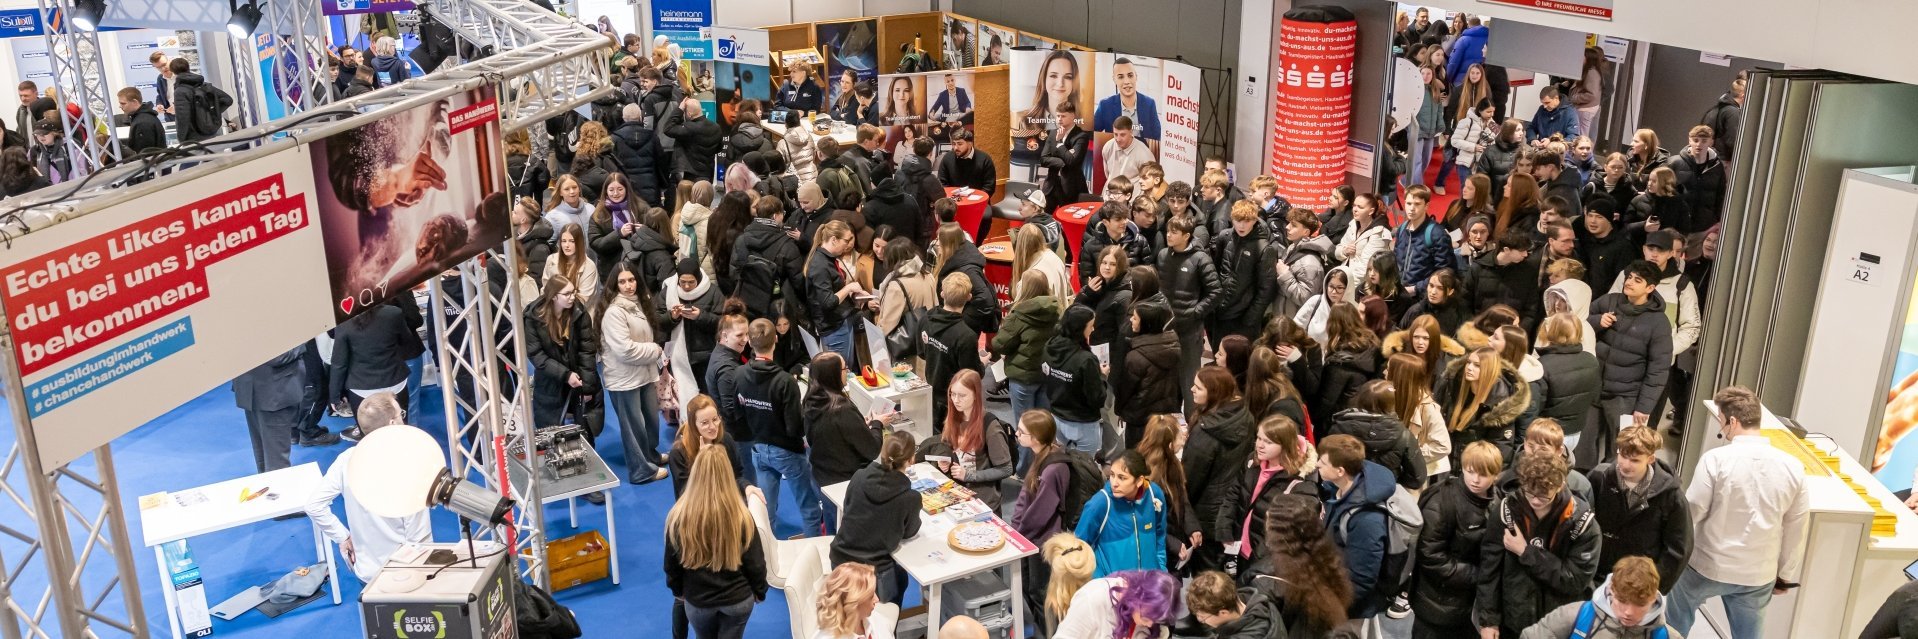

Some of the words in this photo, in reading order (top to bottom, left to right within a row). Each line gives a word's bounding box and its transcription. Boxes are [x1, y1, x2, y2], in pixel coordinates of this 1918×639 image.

[660, 9, 702, 17] heinemann
[1554, 4, 1586, 13] FREUNDLICHE
[1287, 33, 1352, 42] du-machst-uns-aus.de
[1168, 75, 1182, 90] Du
[1246, 87, 1253, 95] A3
[1167, 95, 1200, 114] machst
[451, 115, 464, 125] DAS
[464, 103, 495, 120] HANDWERK
[1166, 112, 1184, 125] uns
[1165, 130, 1172, 138] So
[5, 251, 101, 298] Echte
[107, 219, 186, 260] Likes
[191, 182, 282, 230] kannst
[15, 301, 60, 331] du
[66, 274, 117, 311] bei
[124, 255, 179, 288] uns
[185, 225, 257, 270] jeden
[260, 207, 303, 234] Tag
[1853, 269, 1869, 282] A2
[21, 280, 203, 365] bekommen.
[175, 571, 199, 582] TOPAZIO
[404, 616, 434, 624] SELFIE
[197, 628, 211, 637] OLI
[405, 623, 431, 633] BOX
